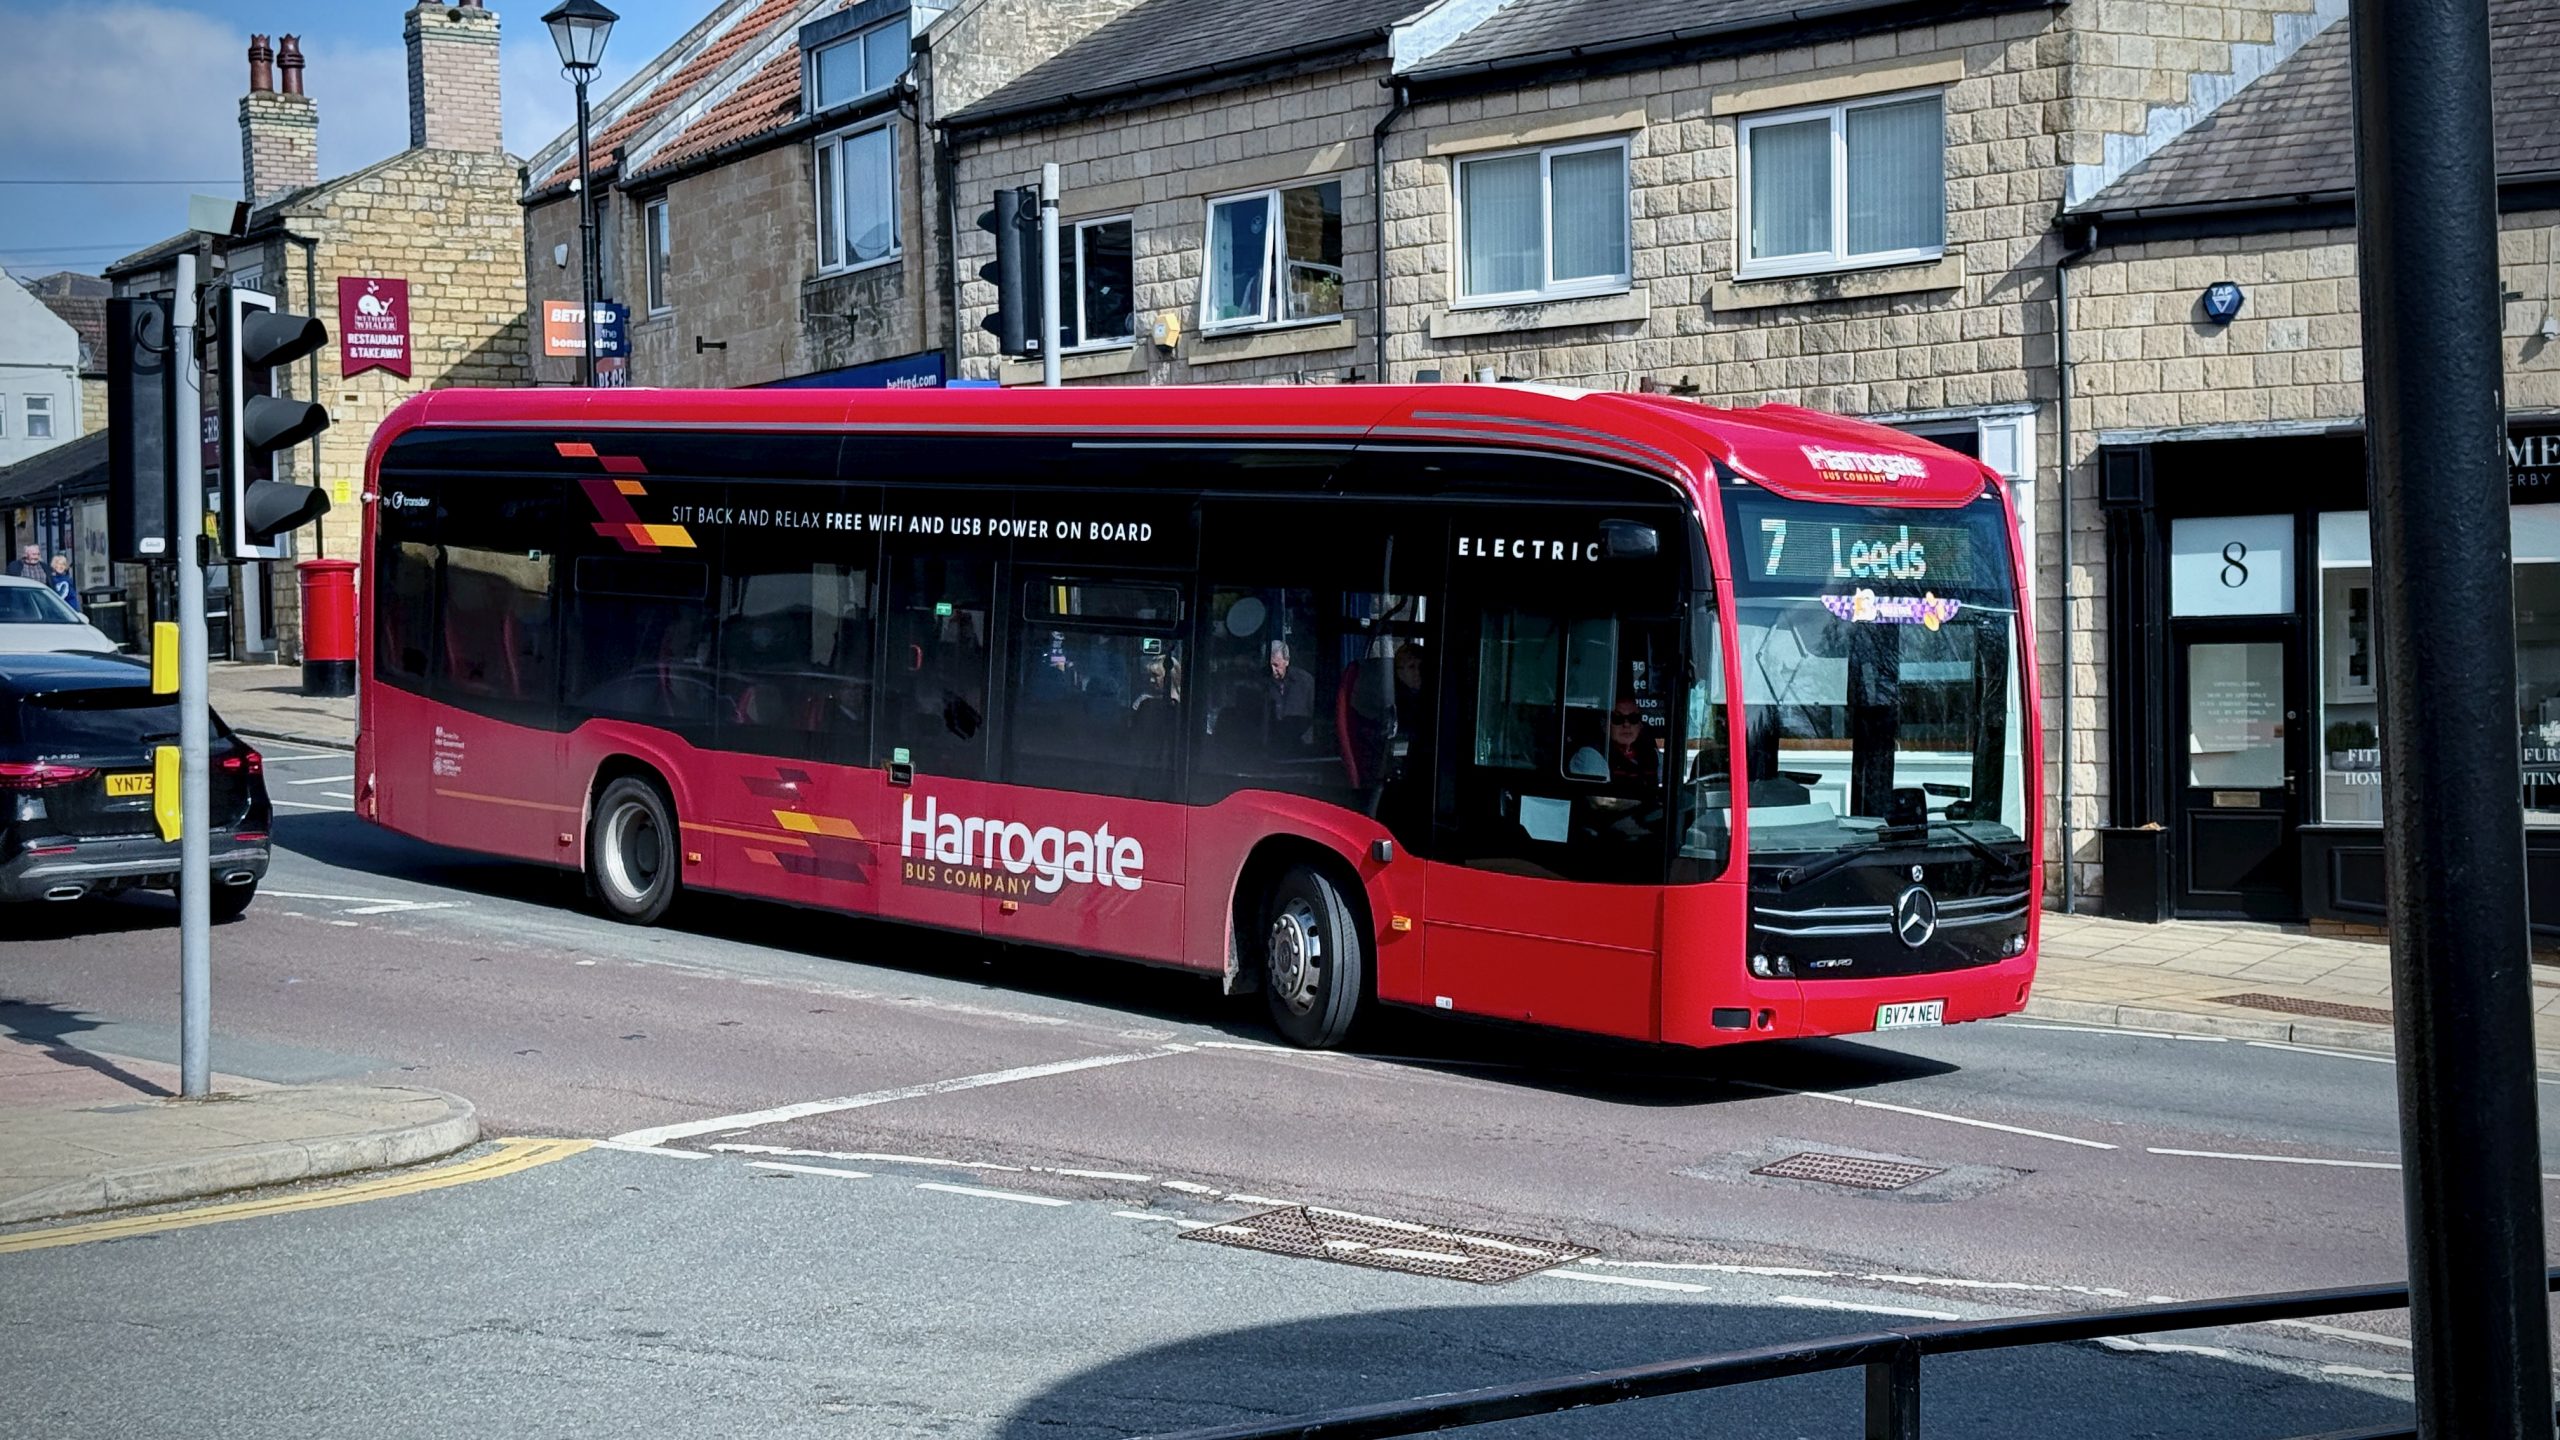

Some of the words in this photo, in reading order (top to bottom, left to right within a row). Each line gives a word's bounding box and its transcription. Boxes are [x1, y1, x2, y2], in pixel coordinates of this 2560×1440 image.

[2210, 286, 2234, 296] TAP
[550, 308, 616, 323] BETFED
[347, 333, 404, 346] RESTAURANT
[1799, 444, 1930, 481] Harrogate
[1822, 471, 1841, 481] BUS
[1843, 472, 1887, 484] COMPANY
[672, 506, 693, 523] SIT
[698, 507, 733, 525] BACK
[738, 509, 769, 527] AND
[775, 510, 820, 529] RELAX
[825, 512, 862, 531] FREE
[868, 514, 903, 533] WIFI
[908, 516, 944, 534] AND
[950, 517, 982, 536] USB
[988, 519, 1049, 538] POWER
[1055, 521, 1082, 540] ON
[1089, 522, 1152, 542] BOARD
[1458, 537, 1599, 562] ELECTRIC
[1761, 518, 1787, 576] 7
[1831, 525, 1927, 580] Leeds
[2220, 541, 2249, 588] 8
[2524, 748, 2560, 762] FUR
[114, 776, 153, 792] YN73
[2522, 771, 2560, 785] TIN
[901, 793, 1144, 894] Harrogate
[905, 862, 936, 882] BUS
[943, 867, 1032, 896] COMPANY
[1884, 1005, 1915, 1025] BV74
[1918, 1004, 1942, 1022] NEU
